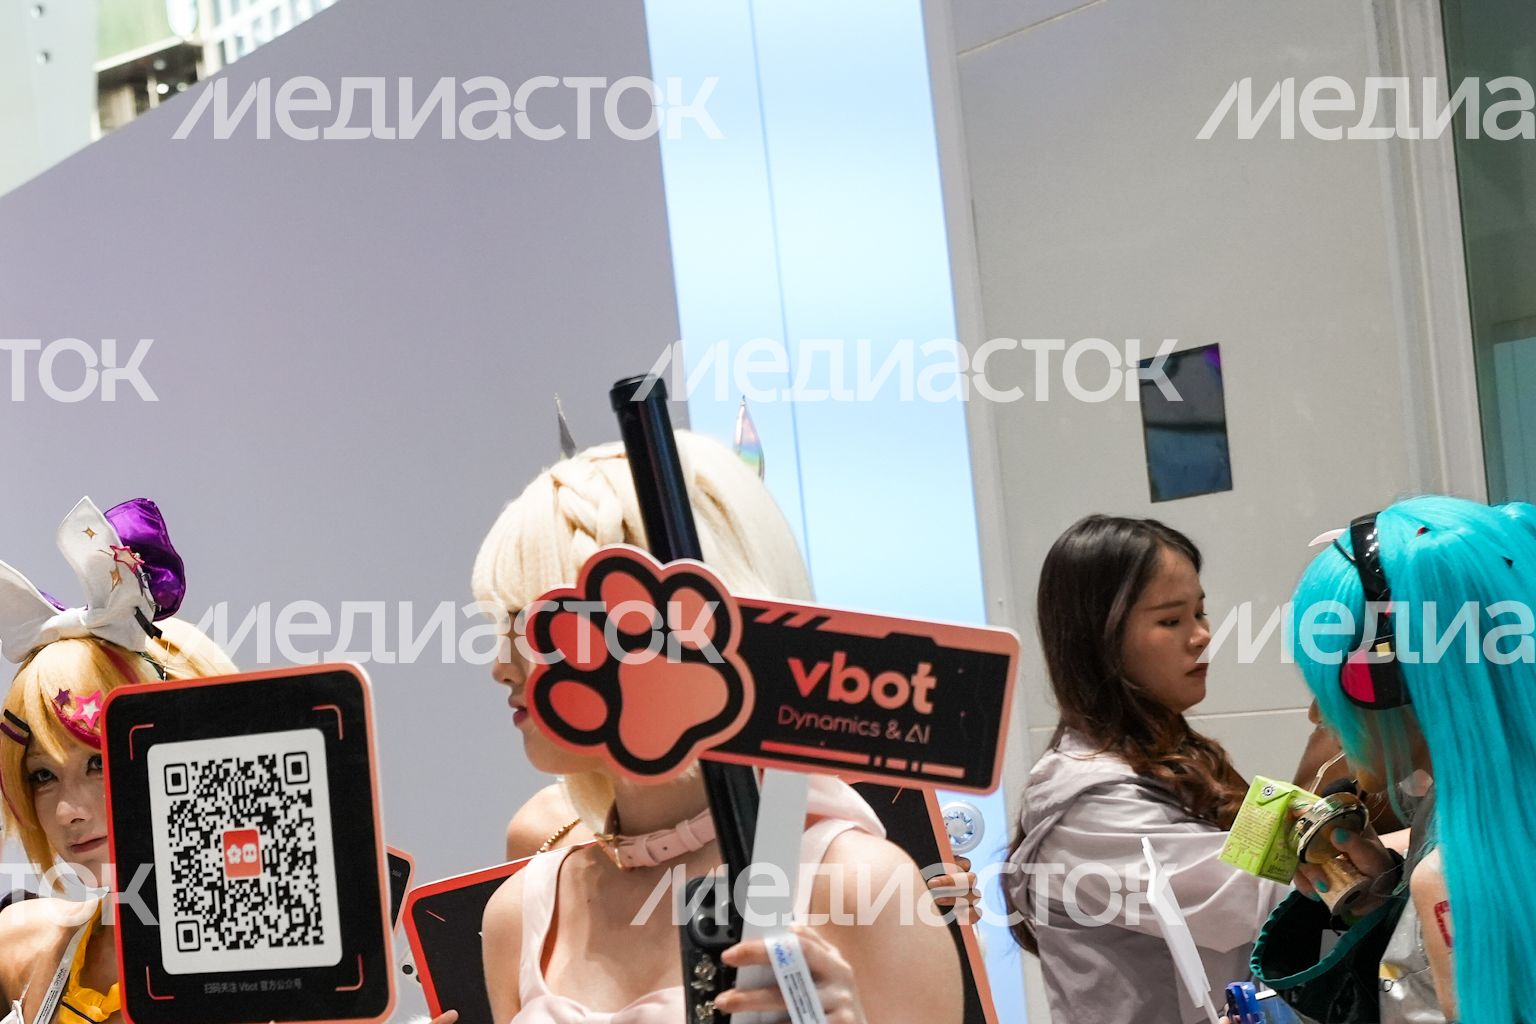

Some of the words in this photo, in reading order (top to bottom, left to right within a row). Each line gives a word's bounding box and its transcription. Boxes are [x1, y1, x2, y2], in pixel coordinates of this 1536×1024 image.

[787, 650, 937, 715] vbot
[777, 704, 880, 740] Dynamics
[886, 719, 902, 740] &
[904, 723, 931, 745] AI
